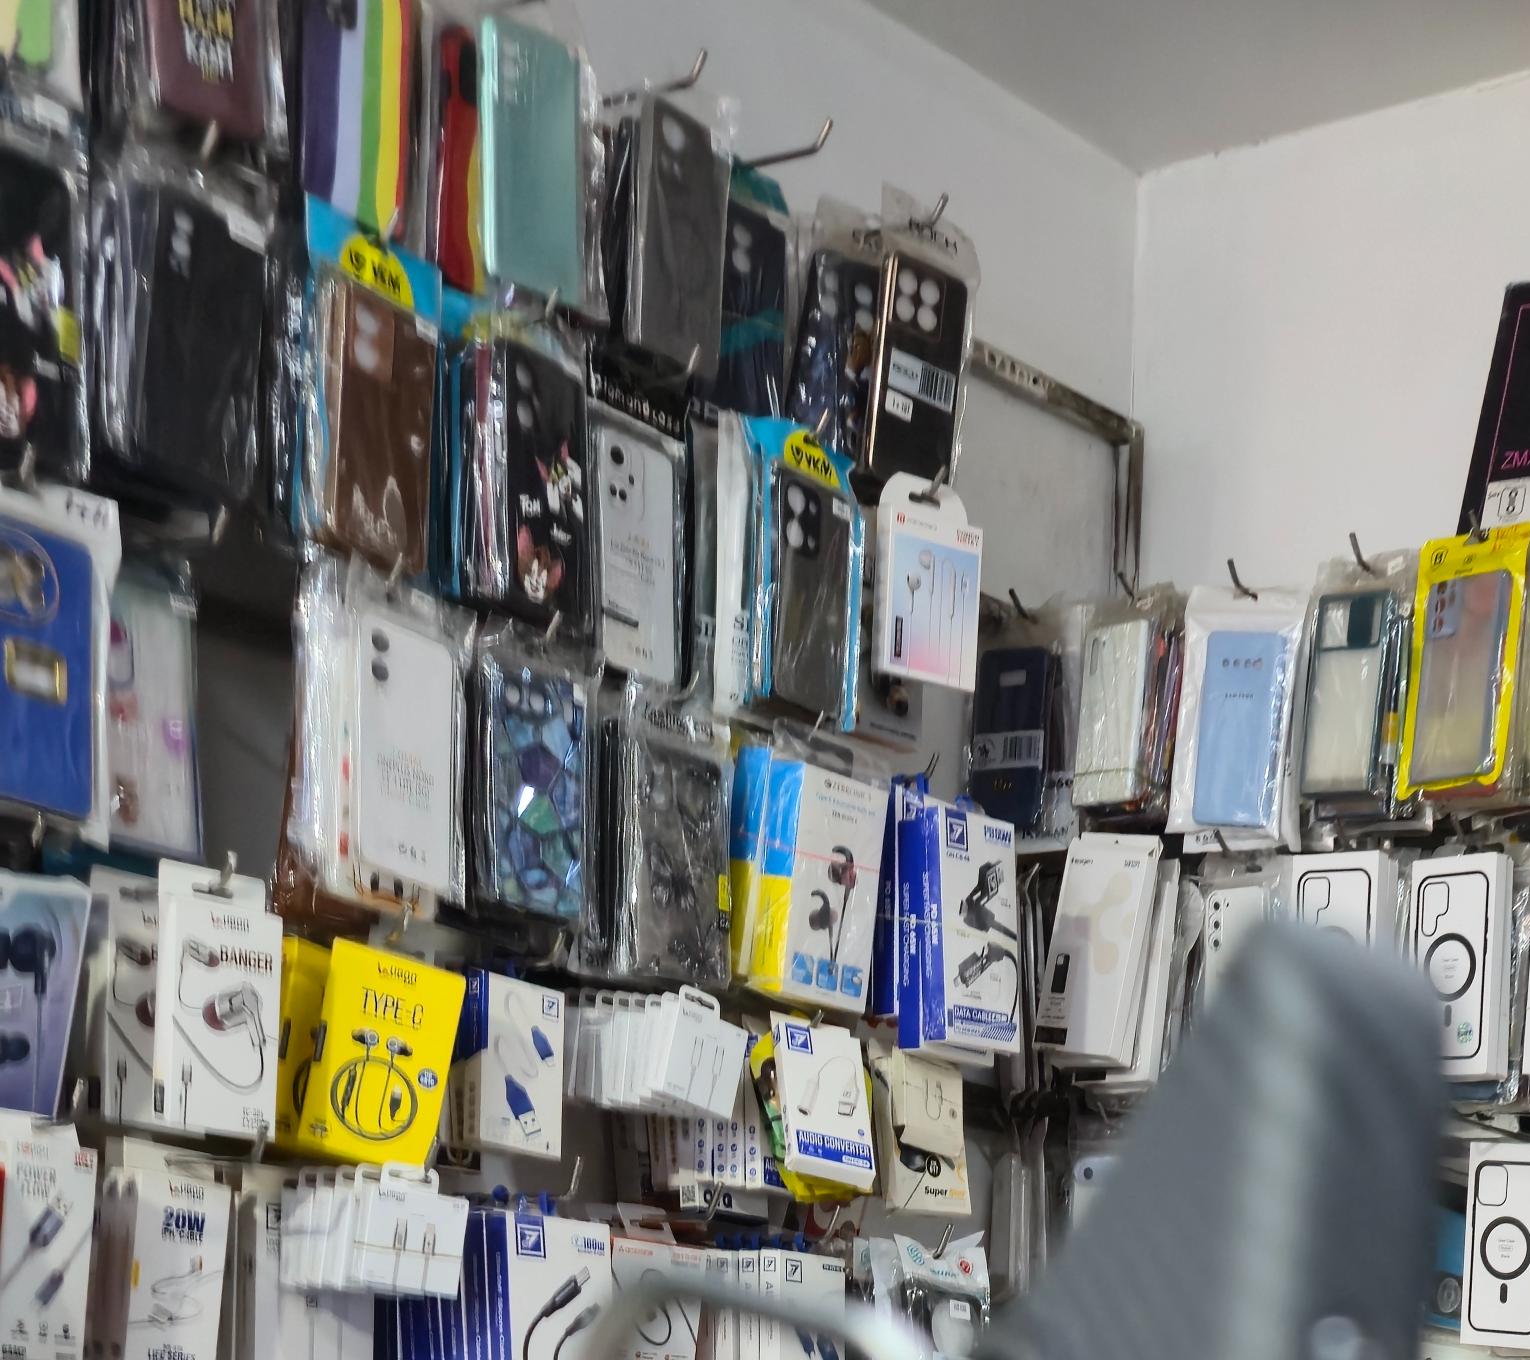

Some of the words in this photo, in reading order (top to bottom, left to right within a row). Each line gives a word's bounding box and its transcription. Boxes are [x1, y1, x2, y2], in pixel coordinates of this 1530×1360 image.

[219, 944, 273, 977] BANGER
[362, 986, 424, 1027] TYPE-C
[798, 1131, 823, 1147] AUDIO
[824, 1134, 871, 1158] CONVERTER
[924, 1185, 947, 1198] Super
[163, 1205, 206, 1232] 20W
